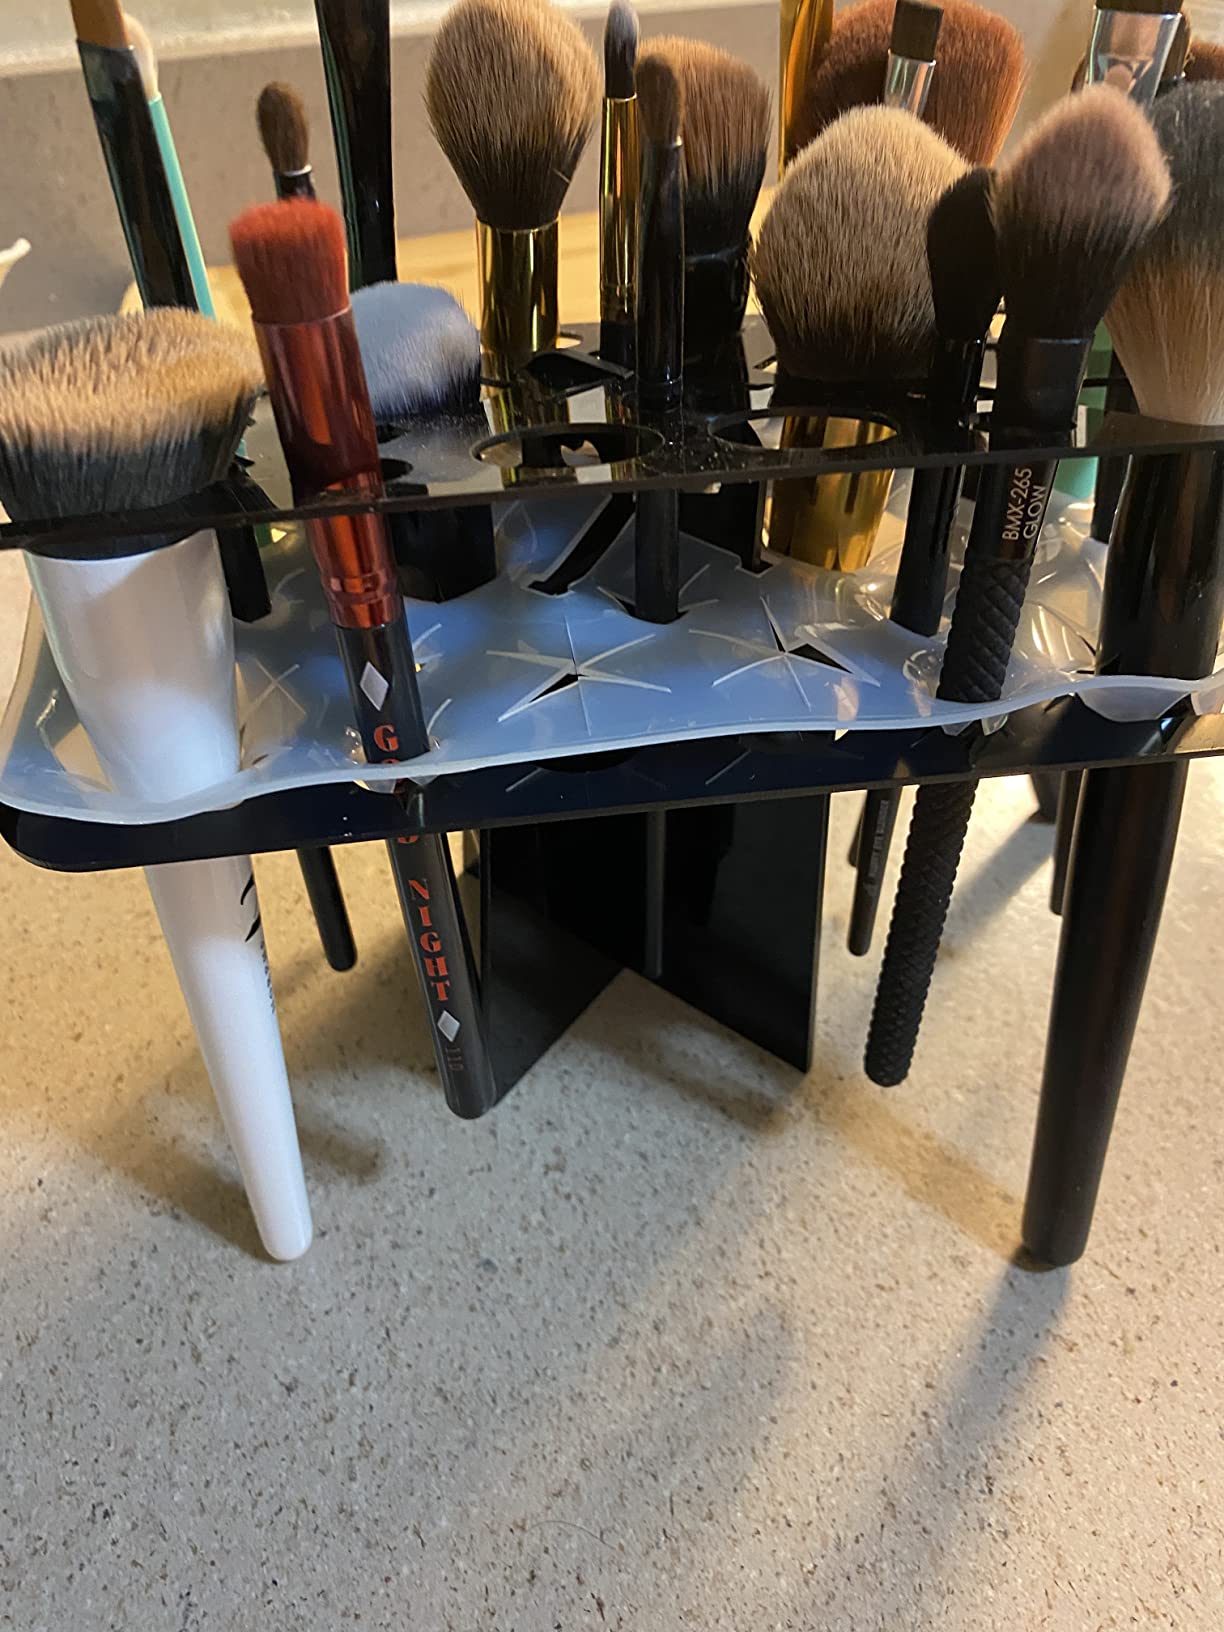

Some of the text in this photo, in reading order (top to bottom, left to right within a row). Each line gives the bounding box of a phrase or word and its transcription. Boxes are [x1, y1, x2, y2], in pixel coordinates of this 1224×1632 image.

[1002, 468, 1033, 540] BMX-265
[1023, 485, 1046, 539] GLOW
[408, 878, 451, 1002] NIGHT
